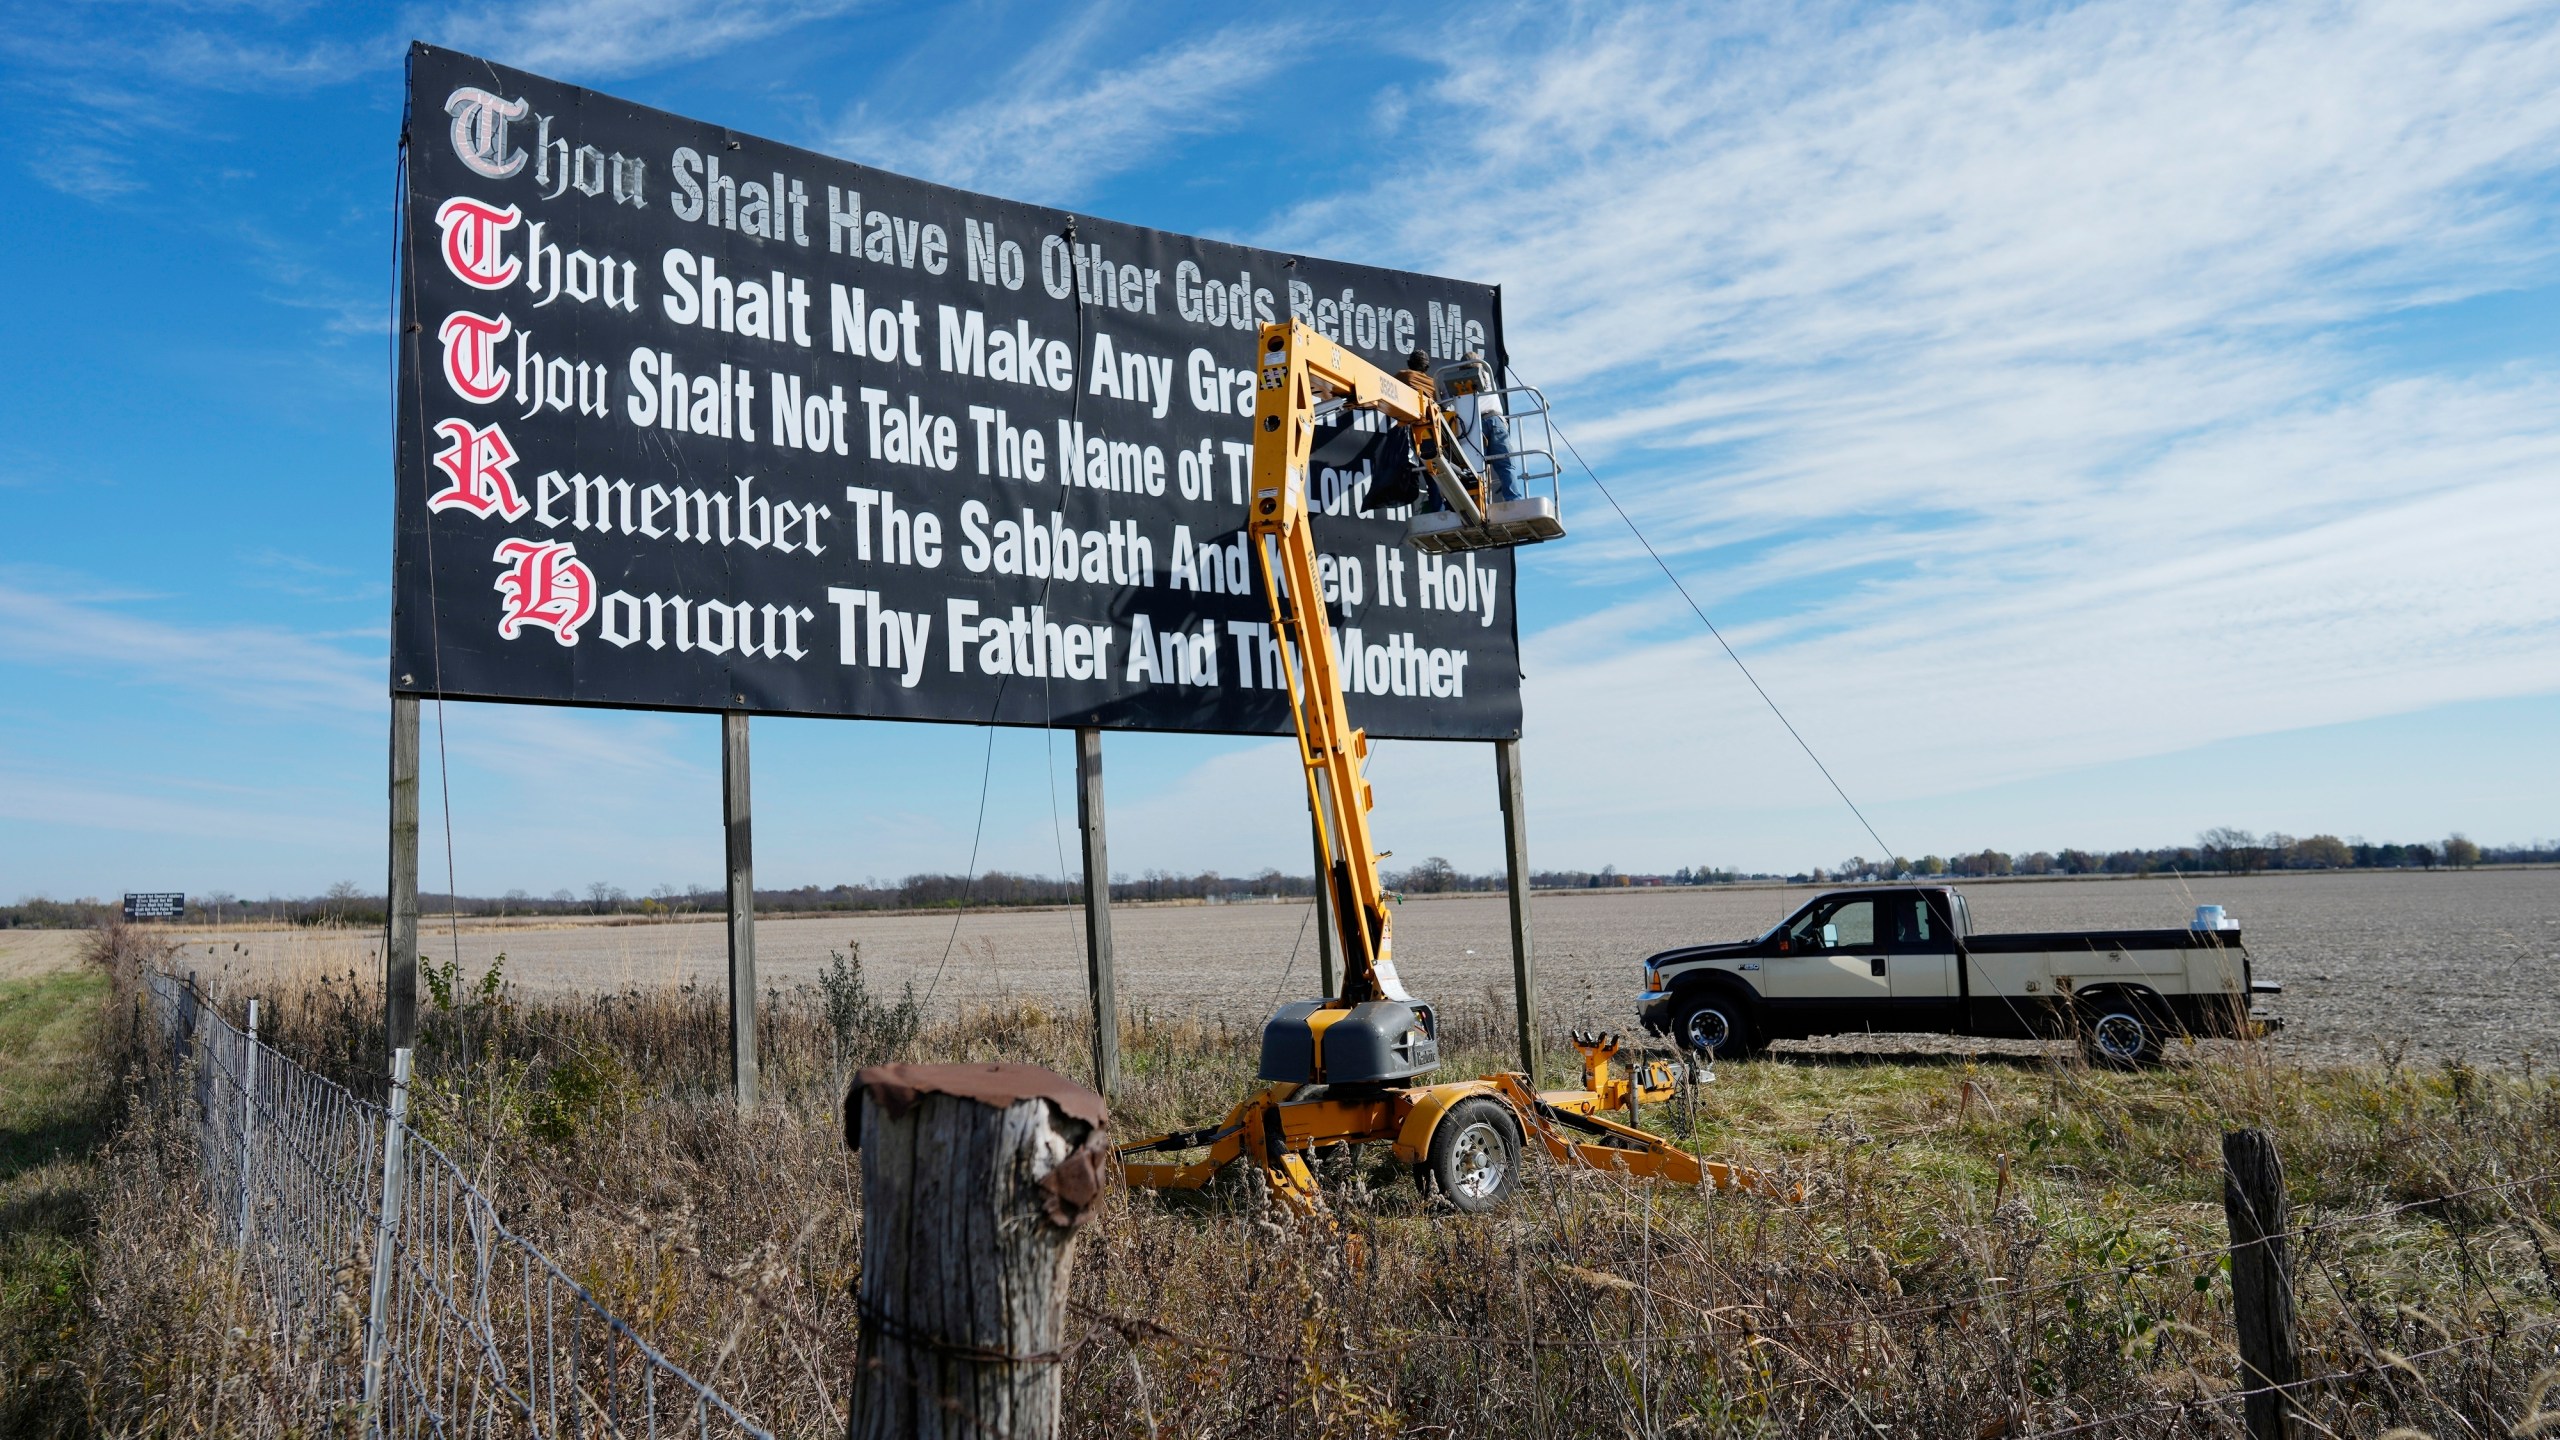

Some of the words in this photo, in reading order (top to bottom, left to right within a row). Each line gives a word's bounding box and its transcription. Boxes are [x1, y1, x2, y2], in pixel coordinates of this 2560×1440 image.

[434, 196, 639, 313] Thou
[662, 248, 811, 348] Shalt
[830, 282, 923, 368] Not
[939, 304, 1073, 393] Make
[1089, 332, 1173, 419] Any
[445, 86, 648, 210] Thou
[670, 146, 810, 247] Shalt
[828, 185, 949, 276] Have
[965, 217, 1025, 291] No
[1041, 234, 1160, 315] Other
[1175, 260, 1277, 331] Gods
[1288, 279, 1415, 354] Before
[1427, 300, 1486, 362] Me
[437, 310, 609, 420] Thou
[627, 346, 755, 443] Shalt
[771, 374, 849, 457] Not
[861, 387, 958, 471] Take
[969, 404, 1045, 483] The
[1058, 419, 1166, 497] Name
[1178, 438, 1215, 502] of
[427, 417, 831, 558] Remember
[847, 485, 943, 569] The
[960, 499, 1154, 587] Sabbath
[1169, 524, 1252, 596] And
[1265, 533, 1364, 617] Kep
[1375, 544, 1408, 608] It
[1417, 550, 1497, 627] Holy
[493, 537, 815, 662] Honour
[828, 586, 930, 688] Thy
[947, 598, 1112, 681] Father
[1126, 613, 1219, 687] And
[1329, 626, 1467, 697] Mother
